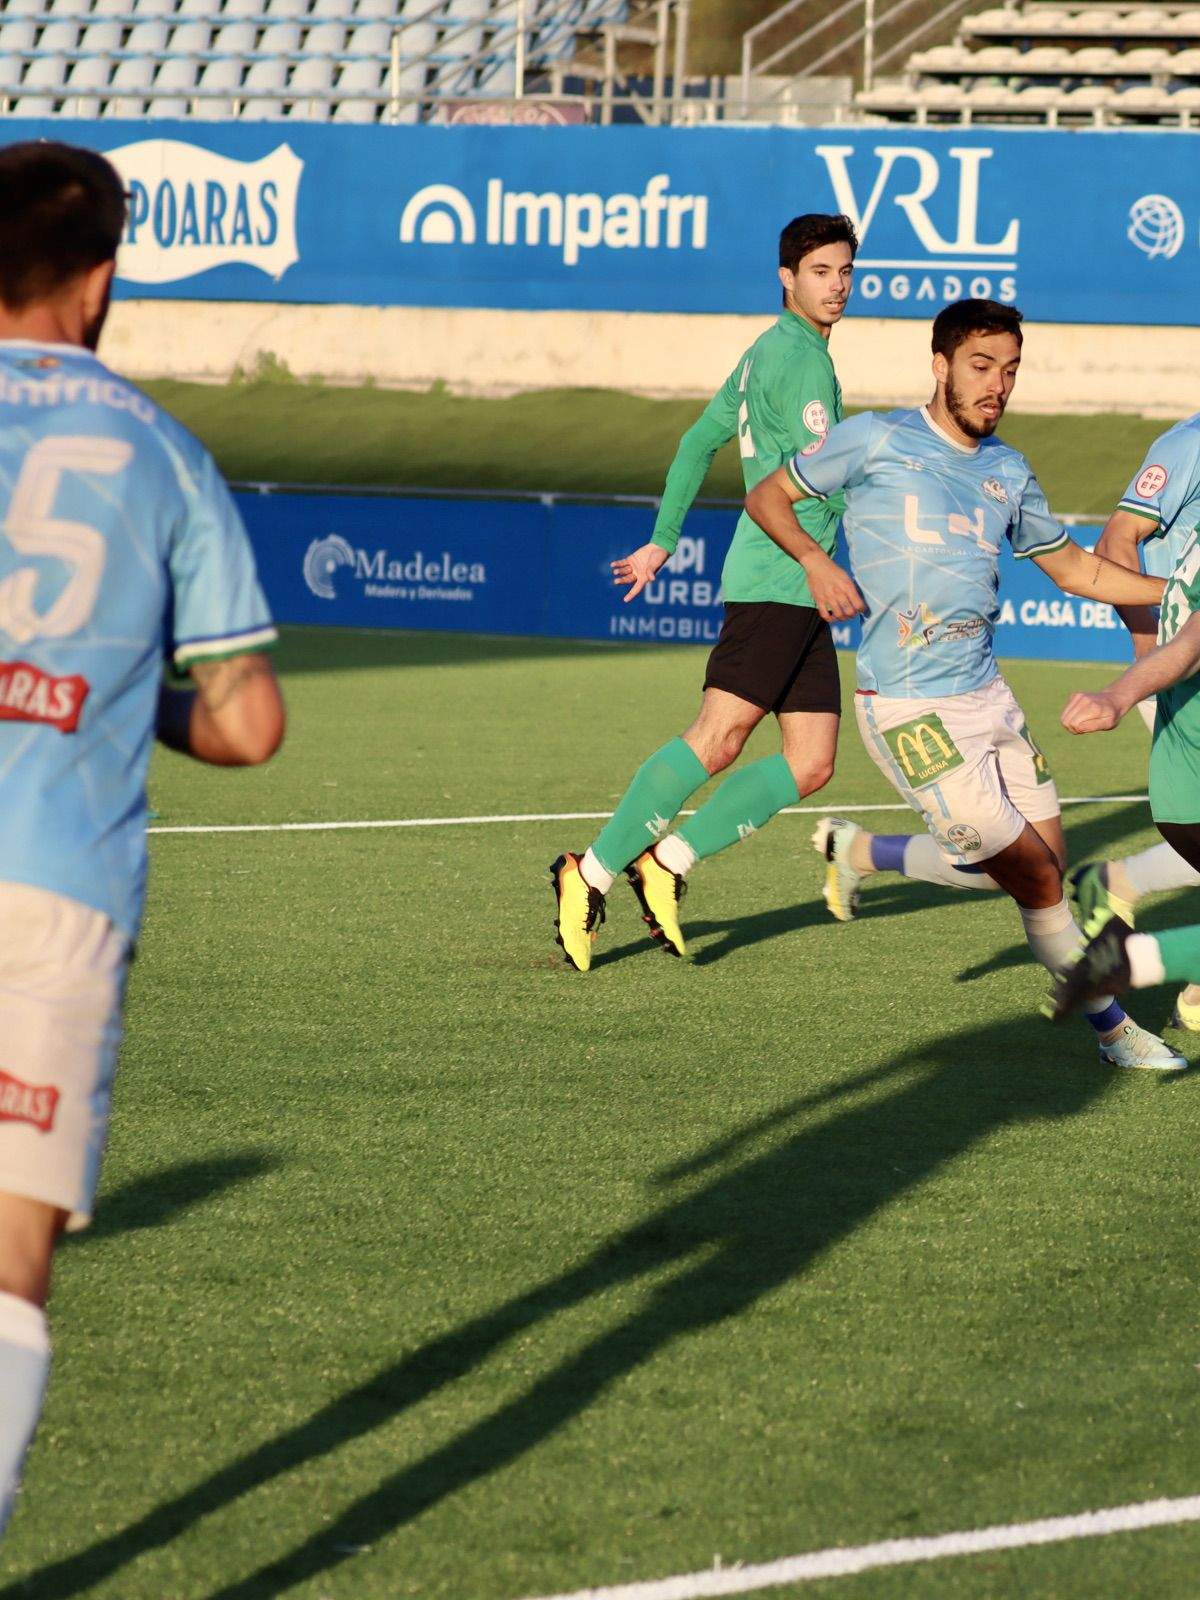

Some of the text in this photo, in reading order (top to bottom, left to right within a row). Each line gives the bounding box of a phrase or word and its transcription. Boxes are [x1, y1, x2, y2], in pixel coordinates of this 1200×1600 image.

[815, 145, 1020, 255] VRL
[487, 174, 708, 265] Impafri
[860, 273, 1018, 303] OGADOS
[0, 435, 135, 645] 5
[355, 549, 486, 583] Madelea
[1020, 600, 1077, 627] CASA
[1079, 603, 1117, 629] DEL
[918, 760, 949, 779] LUCENA
